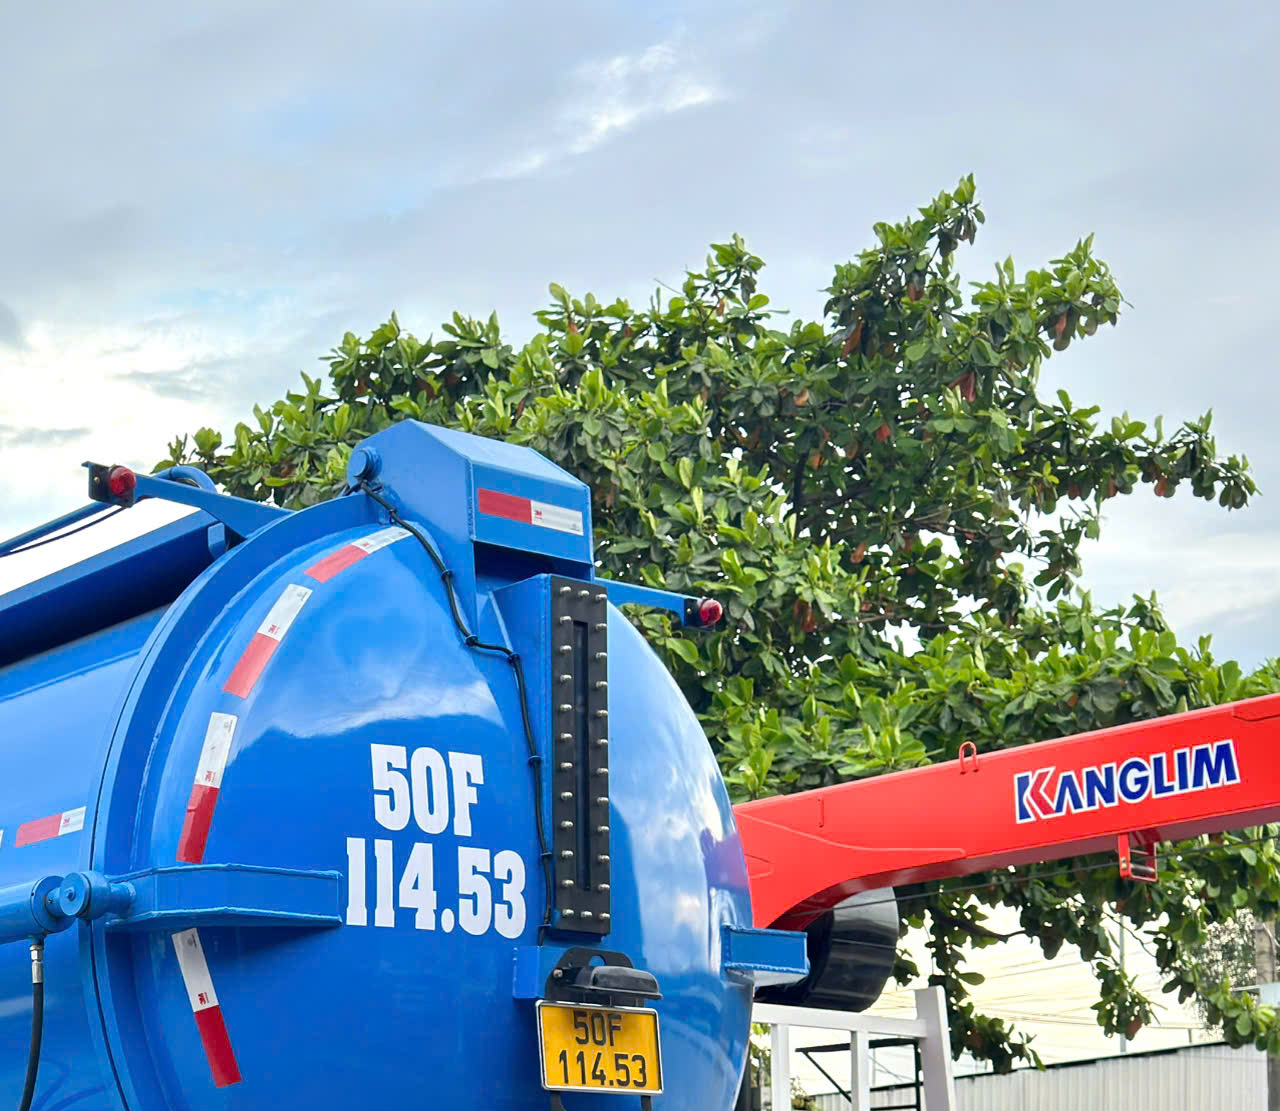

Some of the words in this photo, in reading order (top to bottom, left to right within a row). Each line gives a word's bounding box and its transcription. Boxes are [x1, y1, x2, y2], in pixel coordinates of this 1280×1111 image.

[370, 743, 484, 837] 50F
[1014, 739, 1241, 824] KANGLIM
[346, 837, 526, 939] 114.53
[559, 1049, 647, 1088] 114.53
[573, 1010, 622, 1047] 50F
